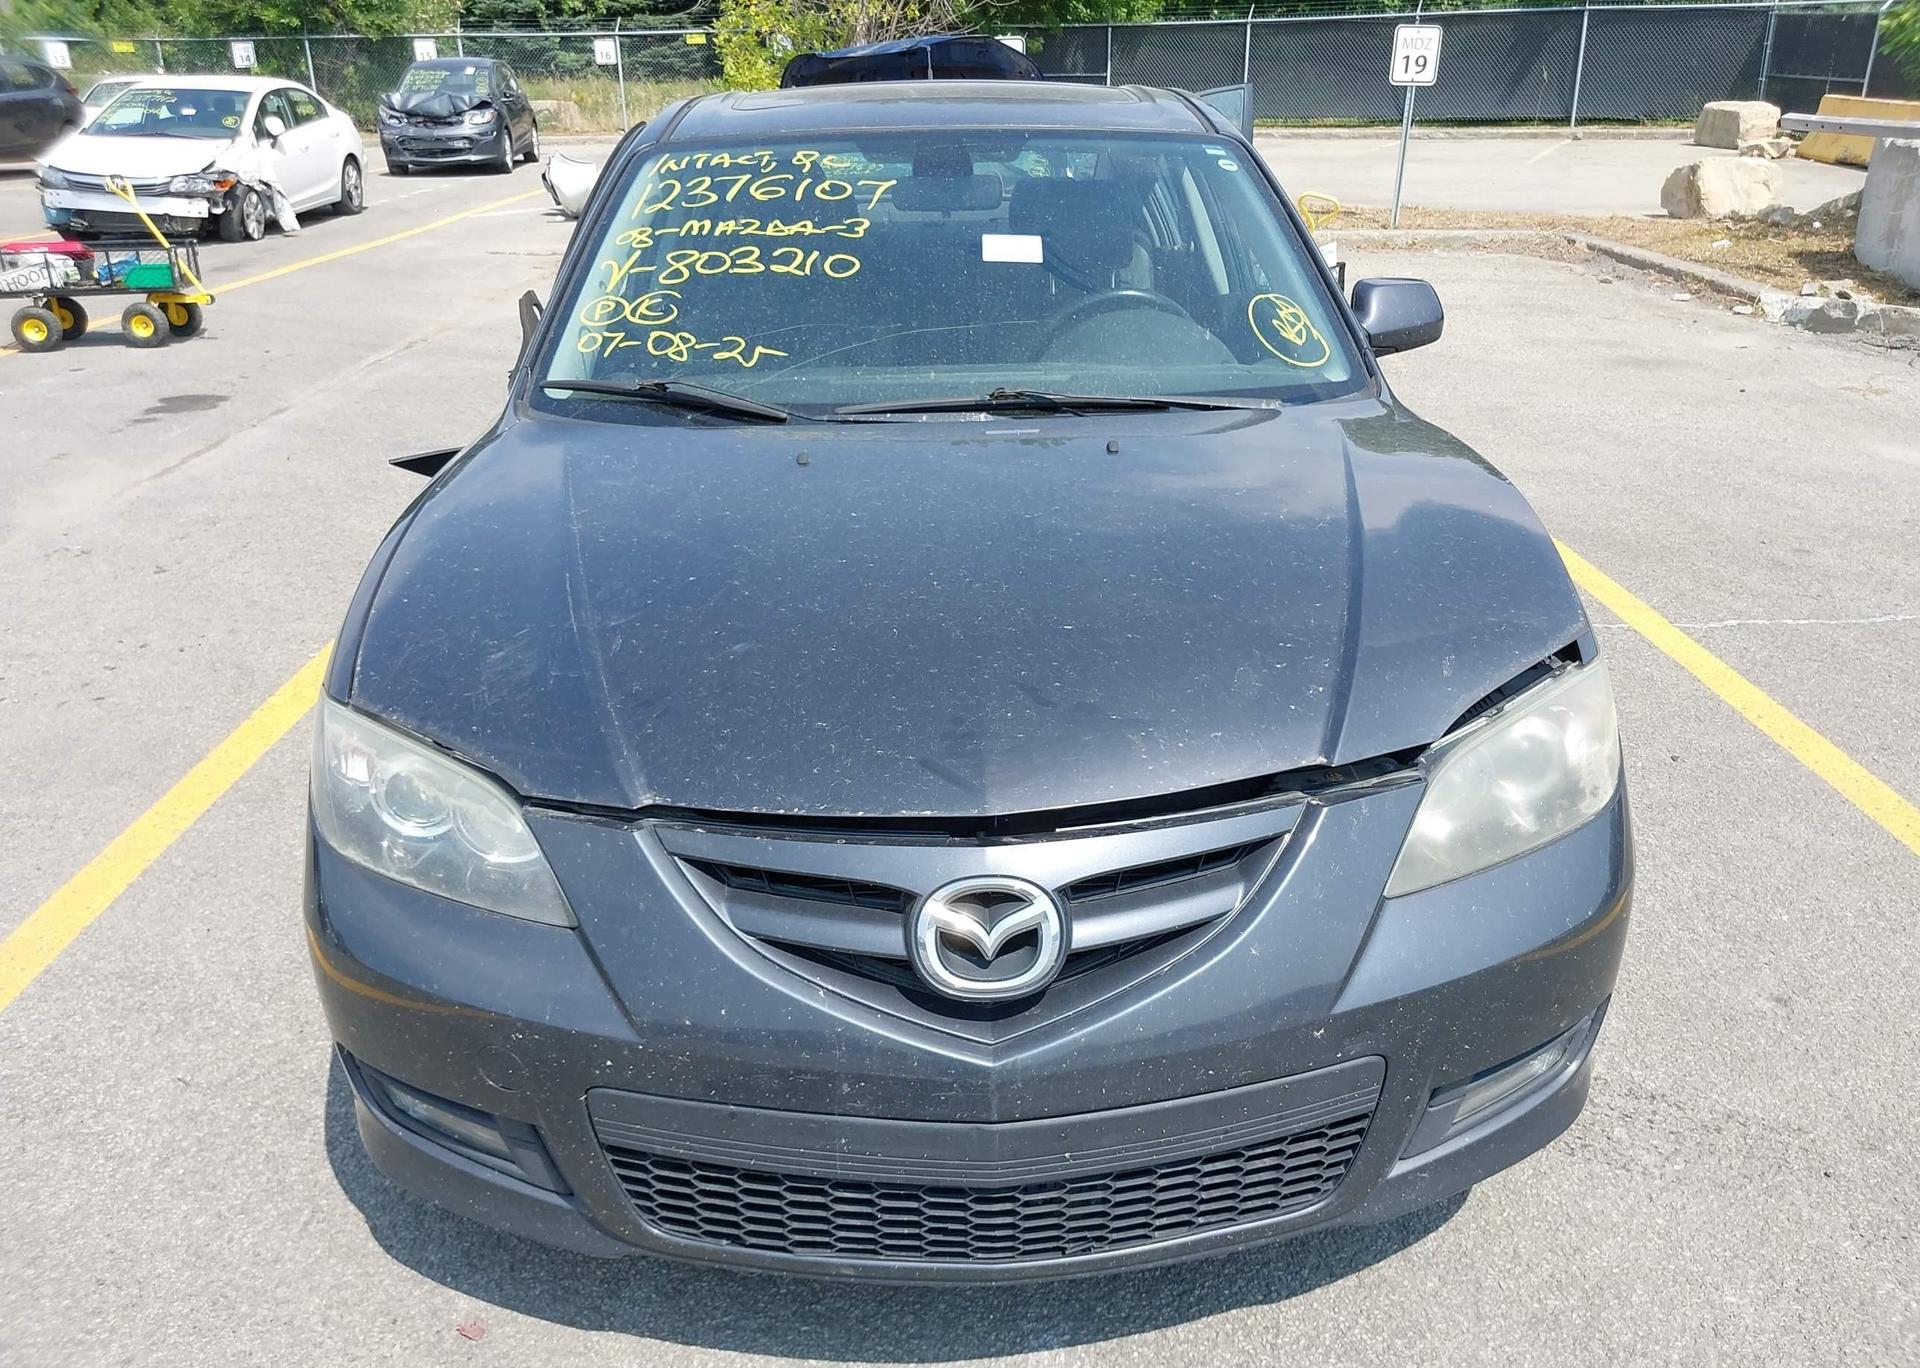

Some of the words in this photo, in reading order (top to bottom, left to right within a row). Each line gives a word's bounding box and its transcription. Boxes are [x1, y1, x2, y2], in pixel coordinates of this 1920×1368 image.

[1401, 36, 1433, 51] MDZ
[599, 51, 611, 61] 16
[1402, 54, 1428, 75] 19
[630, 173, 898, 221] 12376107
